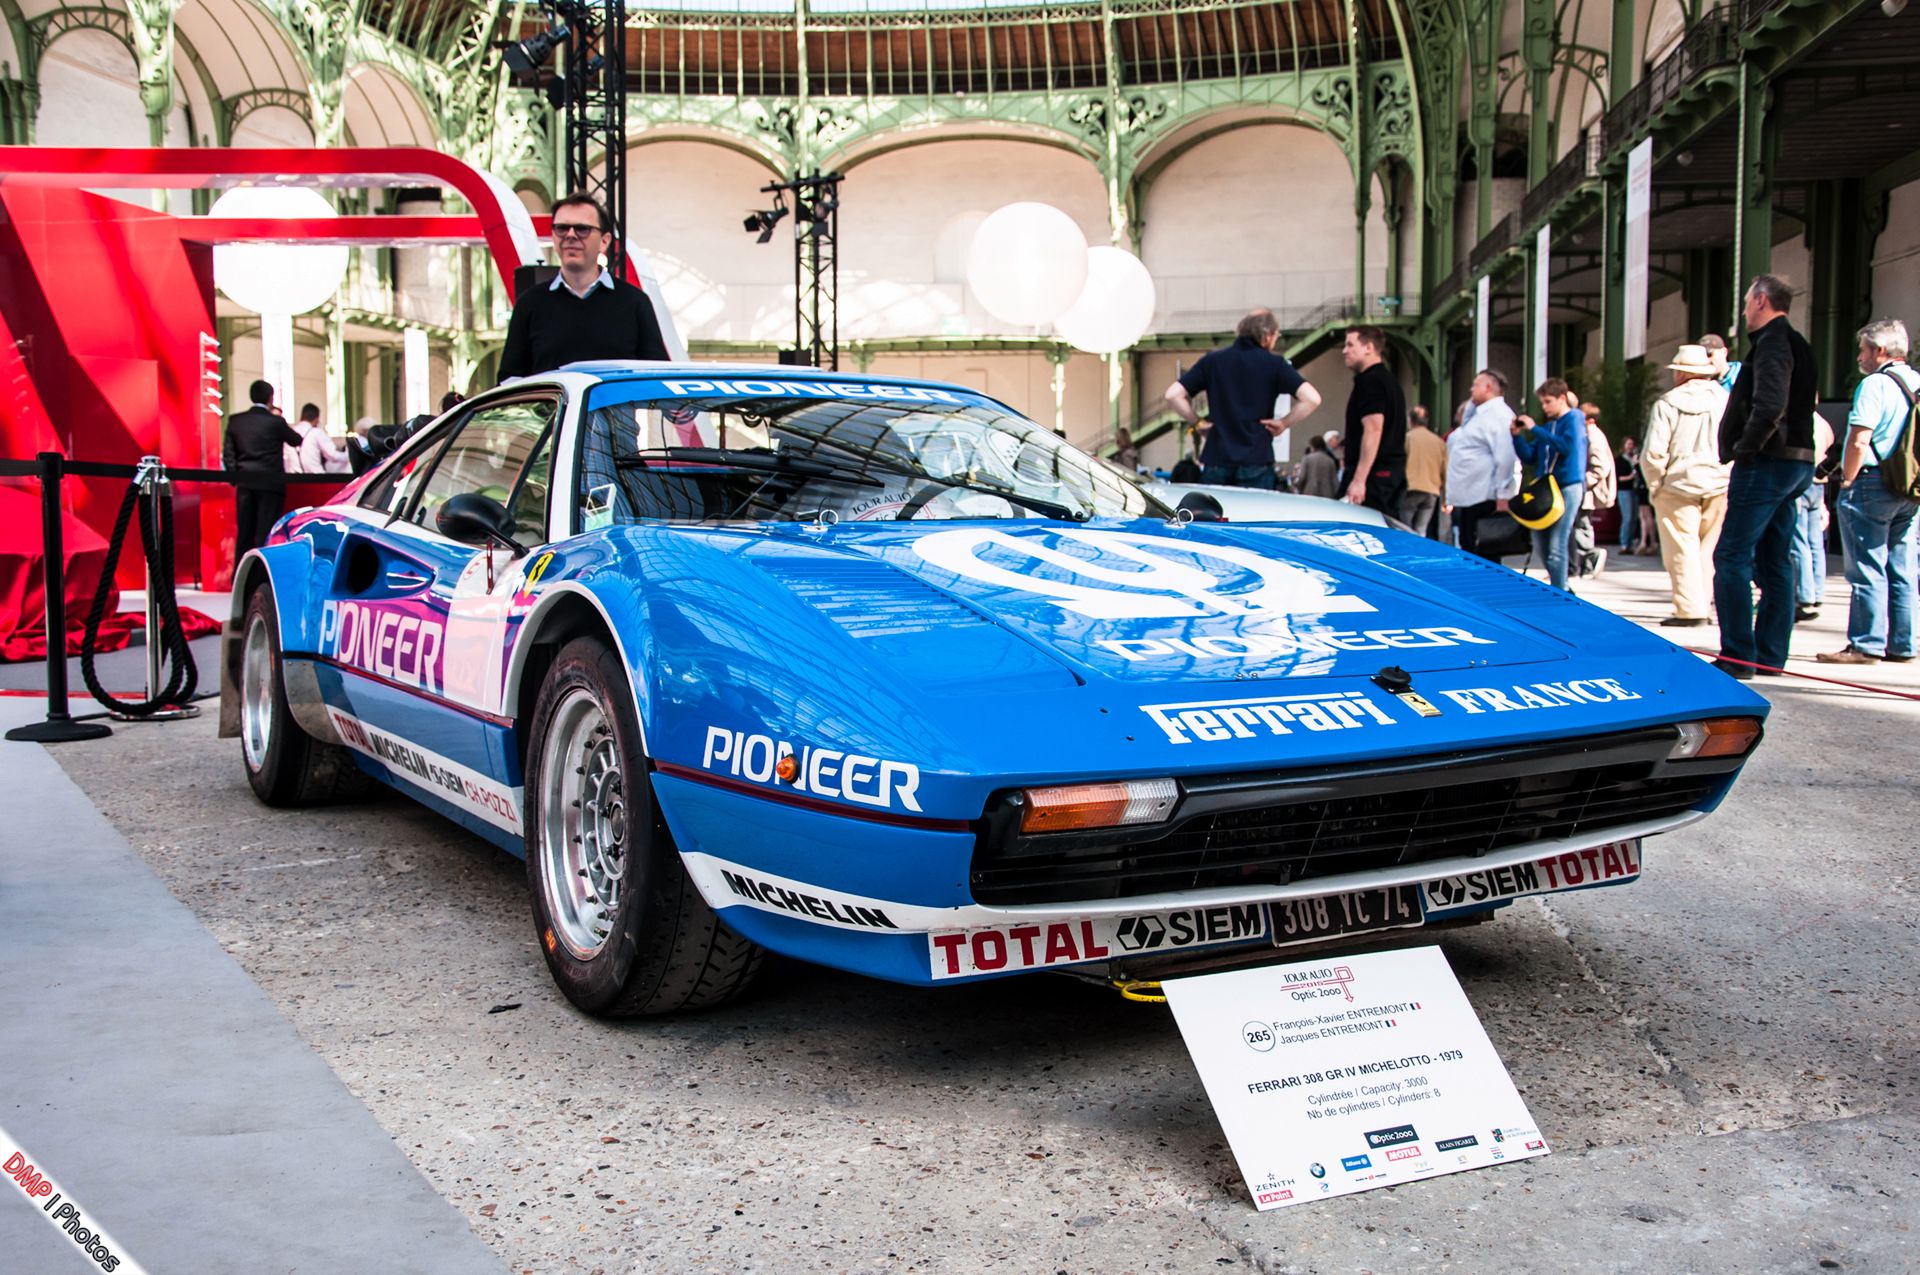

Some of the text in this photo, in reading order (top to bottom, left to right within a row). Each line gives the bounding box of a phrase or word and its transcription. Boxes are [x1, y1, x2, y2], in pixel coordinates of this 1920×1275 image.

[661, 380, 963, 403] PIONEER
[852, 498, 881, 515] TOUR
[884, 492, 912, 504] AUTO
[318, 600, 438, 694] PIONEER
[1095, 627, 1498, 661] PIONEER
[1139, 678, 1643, 745] Ferrari FRANCE
[333, 713, 375, 753] TOTAL
[370, 732, 432, 782] MICHELIN
[702, 725, 924, 812] PIONEER
[1469, 841, 1639, 901] SIEM TOTAL
[720, 869, 900, 929] MICHELIN
[1280, 886, 1411, 934] 308 YC 74
[933, 902, 1262, 974] TOTAL SIEM
[1283, 968, 1333, 984] TOUR AUTO
[1291, 989, 1317, 1003] Optic
[1273, 1003, 1409, 1031] François-Xavier ENTREMONT
[1280, 1020, 1384, 1045] Jacques ENTREMONT
[1247, 1029, 1271, 1043] 265
[1248, 1075, 1302, 1094] FERRARI
[1303, 1071, 1324, 1085] 308
[1325, 1068, 1345, 1081] GR
[1346, 1066, 1357, 1077] IV
[1359, 1053, 1431, 1075] MICHELOTTO
[1439, 1049, 1464, 1062] 1979
[1307, 1088, 1354, 1106] Cylindrée
[1406, 1076, 1429, 1089] 3000
[1307, 1108, 1323, 1120] Nb
[1324, 1105, 1337, 1117] de
[1338, 1097, 1381, 1115] cylindres
[1387, 1090, 1434, 1107] Cylinders:
[1434, 1087, 1442, 1098] 8
[1389, 1146, 1420, 1161] MOTUL
[1255, 1178, 1296, 1192] ZENITH
